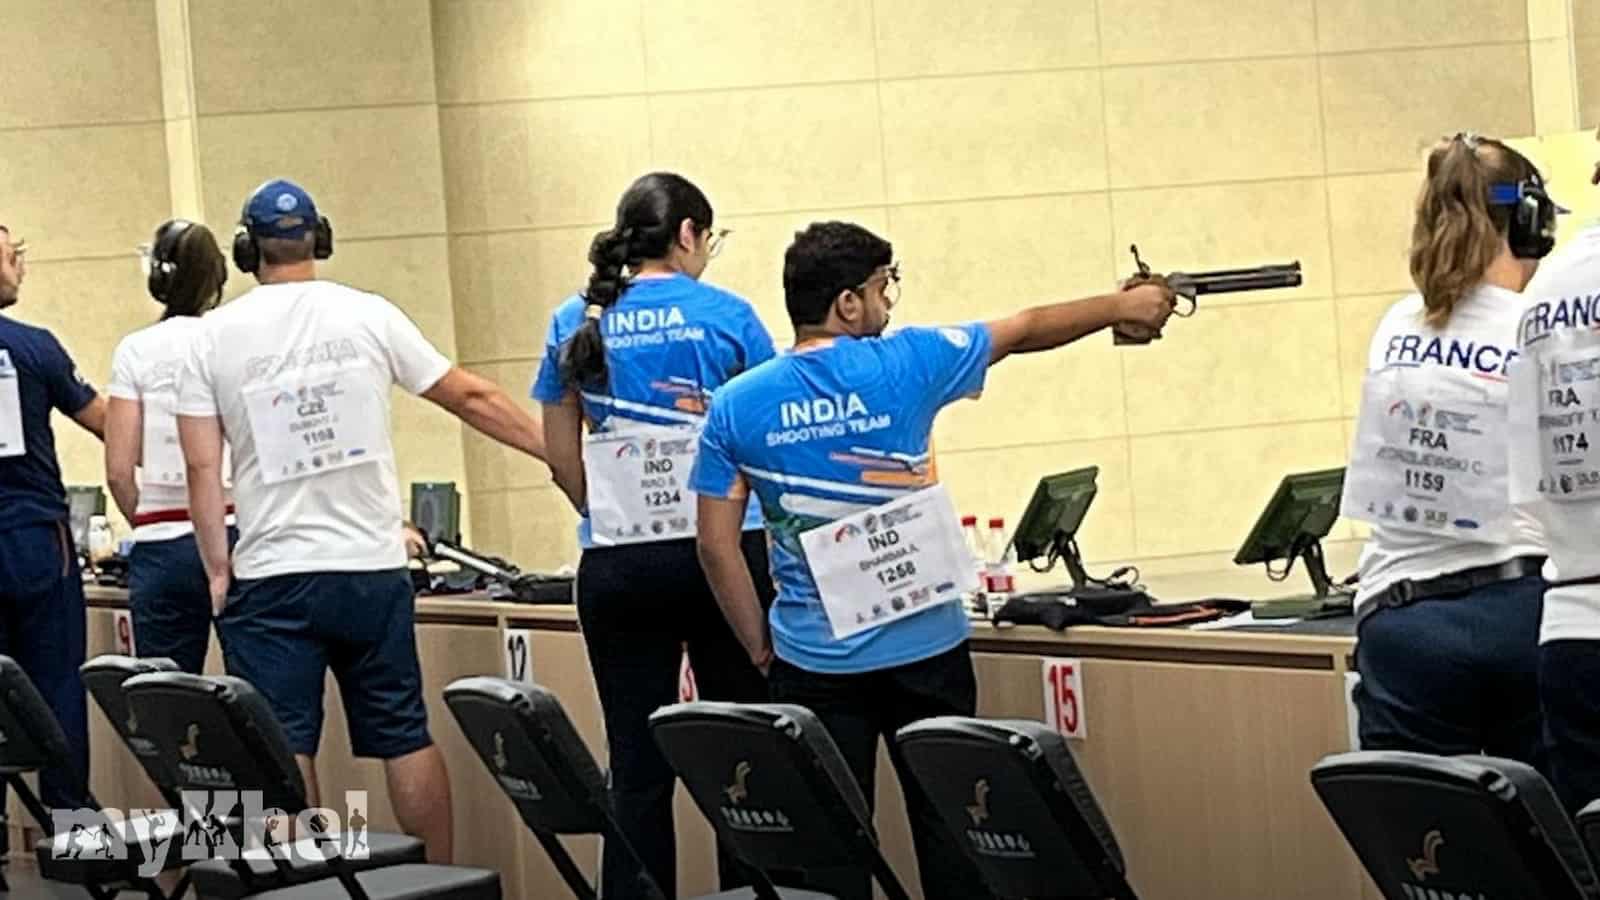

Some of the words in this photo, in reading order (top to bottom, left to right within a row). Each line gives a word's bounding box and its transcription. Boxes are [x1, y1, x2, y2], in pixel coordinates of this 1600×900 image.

[607, 306, 685, 335] INDIA
[667, 327, 705, 342] TEAM
[780, 392, 868, 428] INDIA
[765, 422, 846, 447] SHOOTING
[847, 414, 892, 434] TEAM
[1408, 428, 1449, 451] FRA
[644, 458, 673, 475] IND
[1404, 469, 1445, 492] 1159
[645, 489, 681, 507] 1234
[867, 529, 900, 552] IND
[507, 635, 527, 682] 12
[1048, 664, 1078, 735] 15
